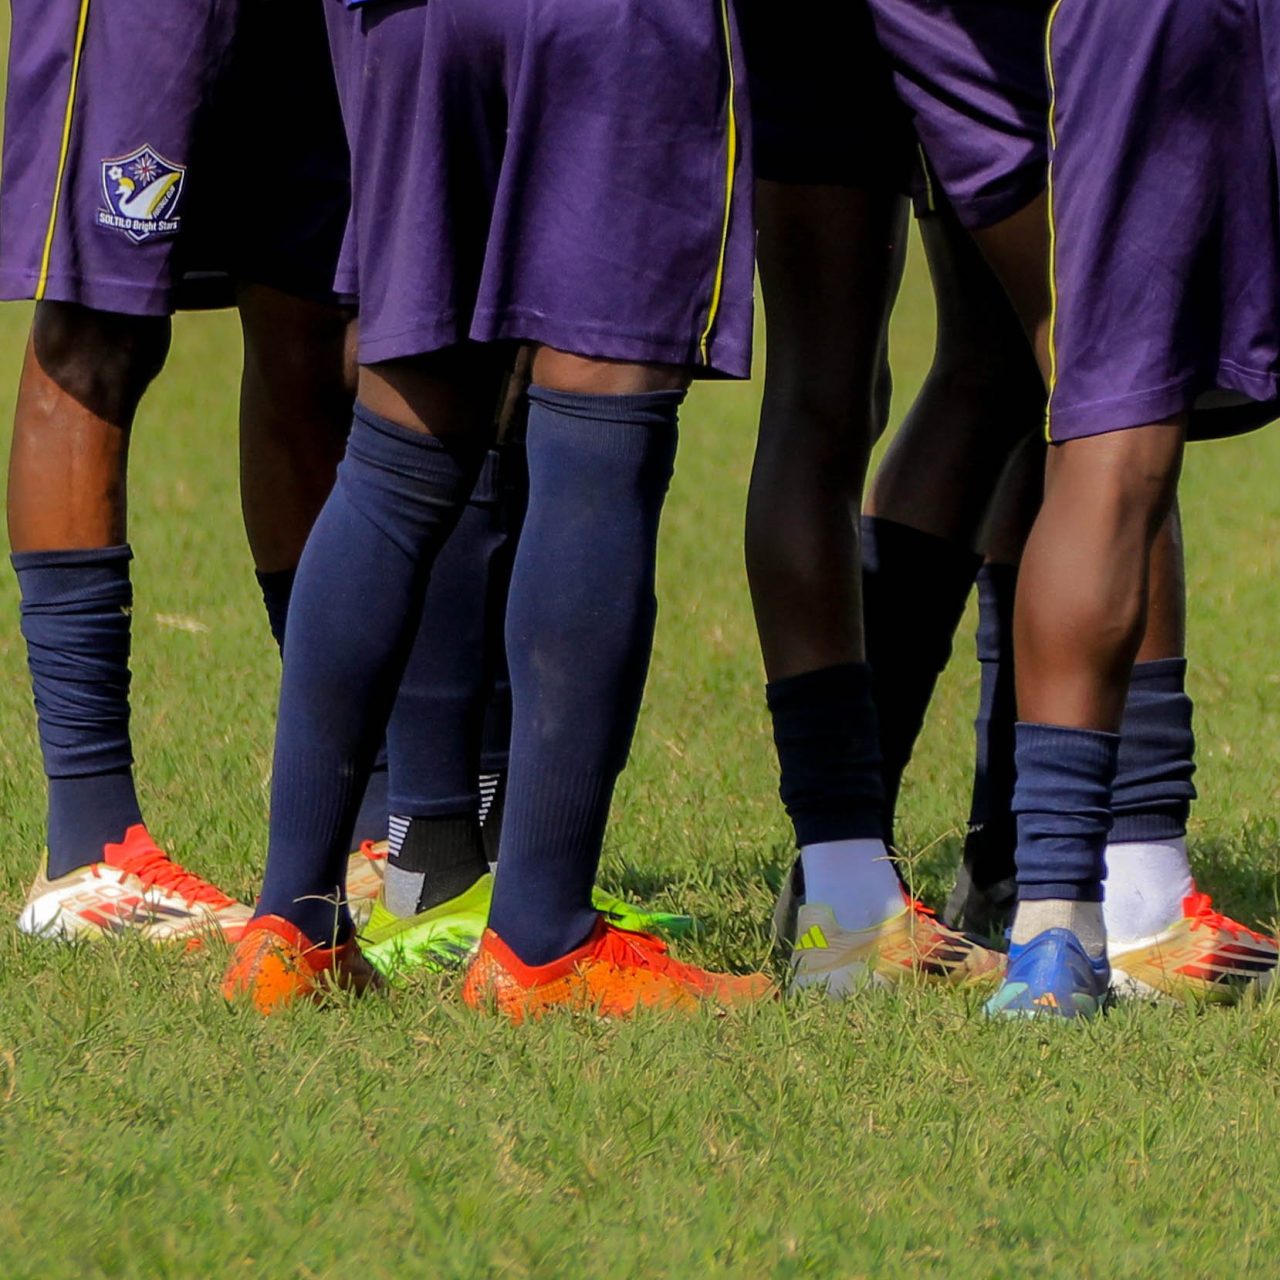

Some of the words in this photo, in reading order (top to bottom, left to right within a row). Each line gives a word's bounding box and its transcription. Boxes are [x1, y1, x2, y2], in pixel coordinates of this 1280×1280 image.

[99, 212, 132, 229] SOLTILO
[133, 220, 157, 233] Bright
[158, 220, 178, 231] Stars
